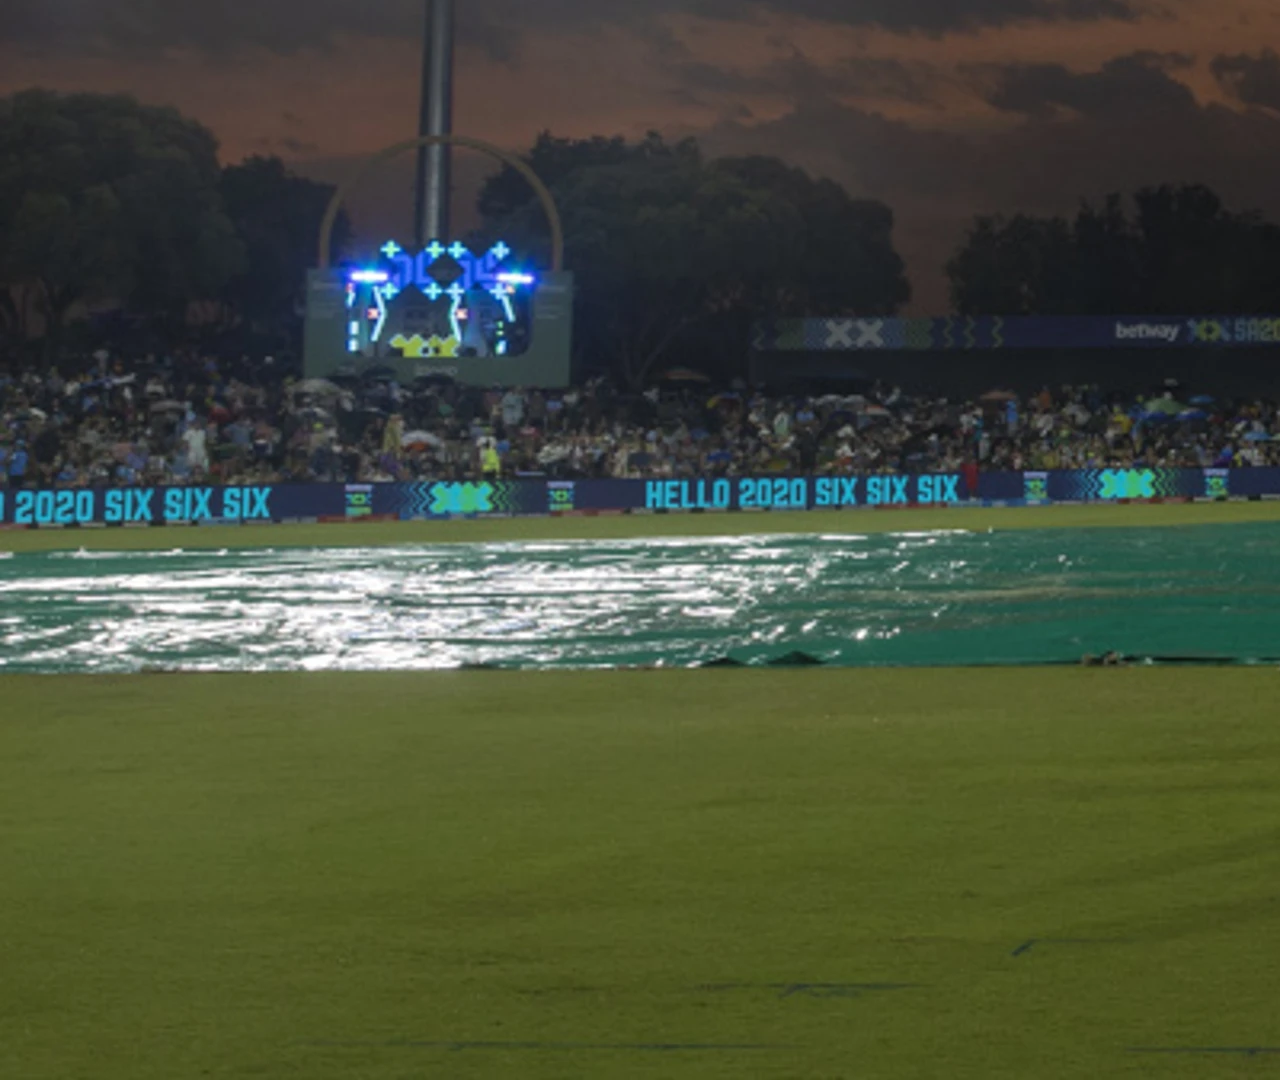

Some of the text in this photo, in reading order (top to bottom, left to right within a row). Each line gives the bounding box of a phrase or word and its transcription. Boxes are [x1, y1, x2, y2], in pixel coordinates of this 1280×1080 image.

[1115, 322, 1180, 342] betway
[14, 489, 95, 523] 2020
[104, 488, 154, 522] SIX
[162, 487, 213, 521] SIX
[222, 486, 272, 520] SIX
[645, 474, 959, 509] HELLO 2020 SIX SIX SIX
